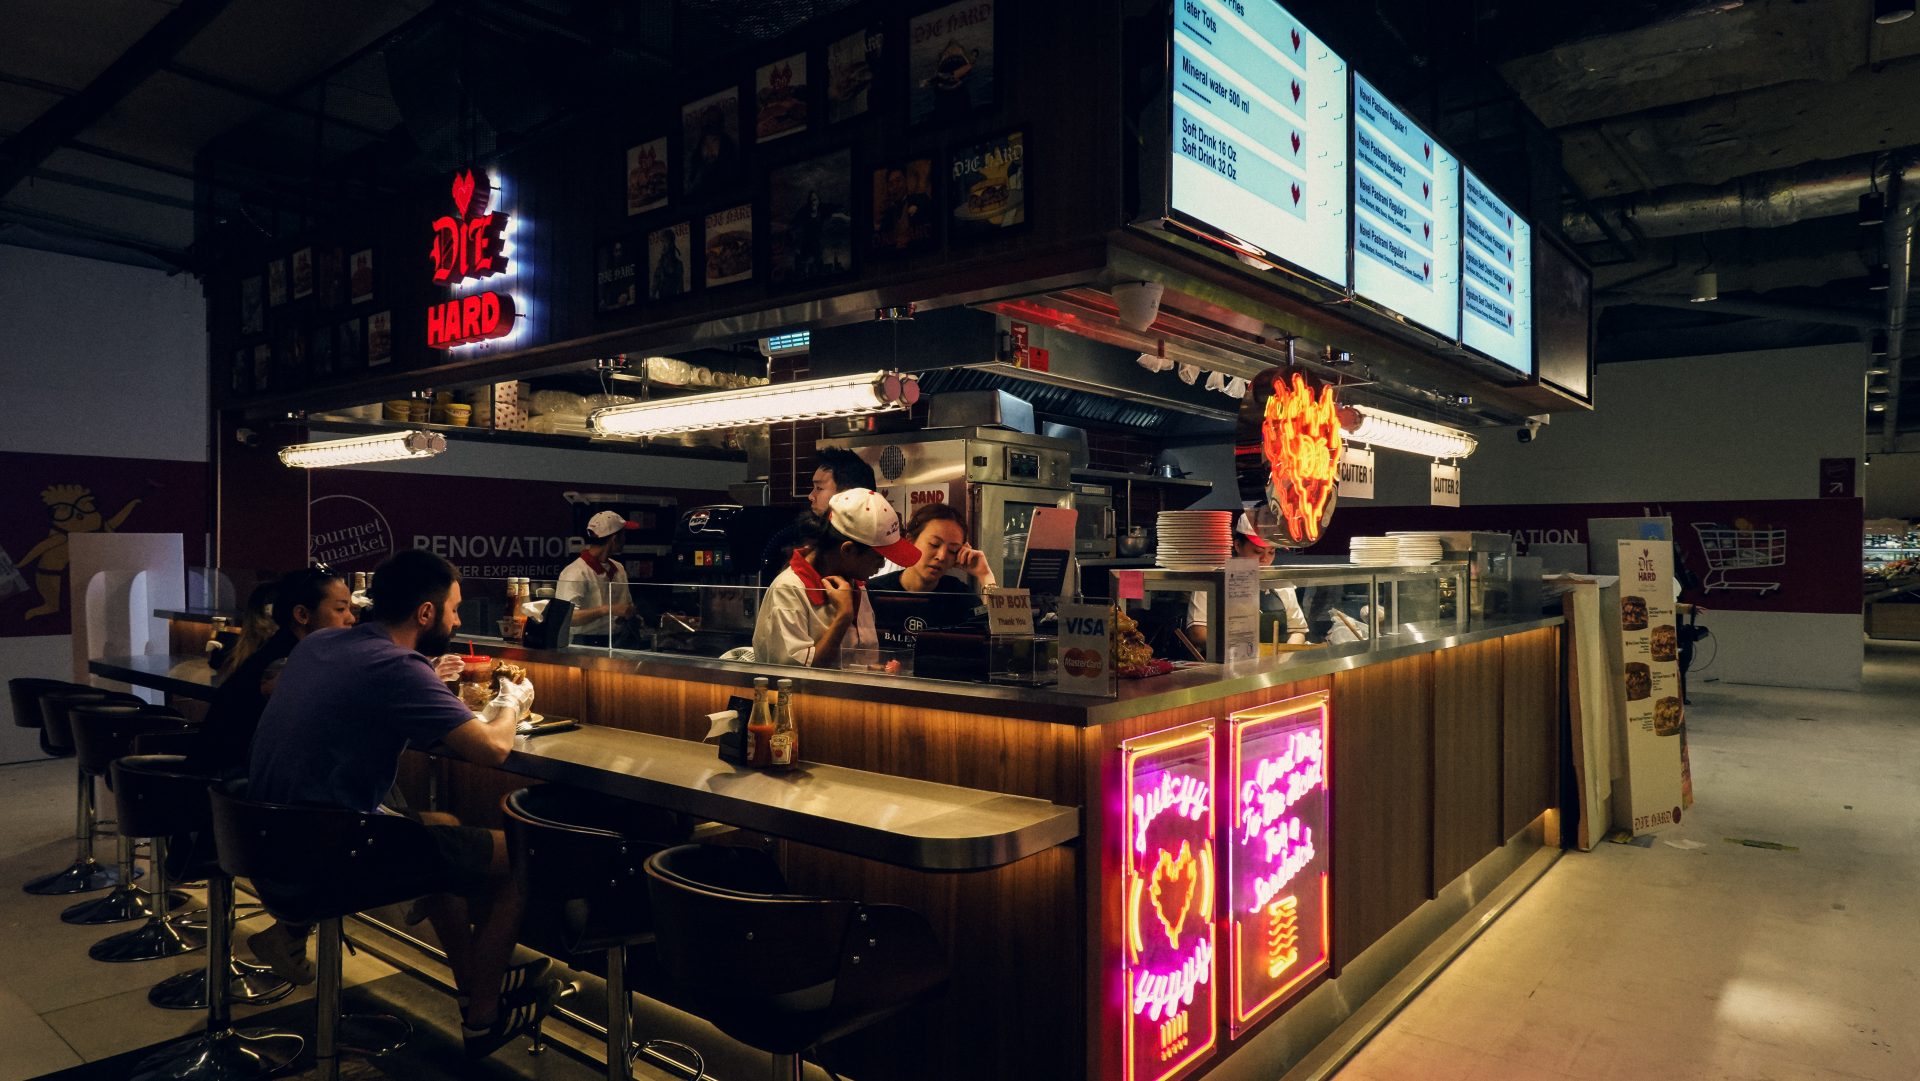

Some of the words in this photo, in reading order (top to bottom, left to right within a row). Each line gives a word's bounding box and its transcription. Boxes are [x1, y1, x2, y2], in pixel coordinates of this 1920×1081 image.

[1202, 10, 1216, 33] Tots
[1182, 56, 1208, 84] Mineral
[1210, 79, 1228, 99] water
[1229, 90, 1240, 108] 500
[1242, 101, 1250, 114] ml
[1372, 96, 1389, 120] Pastrami
[1182, 118, 1197, 139] Soft
[1198, 128, 1217, 150] Drink
[1218, 140, 1226, 155] 16
[1228, 144, 1237, 162] Oz
[1182, 137, 1197, 157] Soft
[1198, 146, 1217, 168] Drink
[1218, 158, 1226, 173] 32
[1228, 163, 1237, 180] Oz
[1371, 140, 1388, 164] Pastrami
[1372, 186, 1388, 207] Pastrami
[430, 214, 494, 282] DIE
[1372, 230, 1388, 249] Pastrami
[427, 291, 501, 346] HARD
[1342, 463, 1367, 484] CUTTER
[1370, 468, 1372, 484] 1
[1434, 477, 1454, 494] CUTTER
[1455, 481, 1459, 494] 2
[911, 490, 944, 504] SAND
[1510, 529, 1579, 544] ATION
[320, 534, 387, 564] market
[459, 565, 479, 577] TER
[1638, 572, 1656, 582] HARD
[989, 595, 1004, 608] TIP
[1008, 595, 1028, 608] BOX
[1016, 618, 1026, 626] You
[1066, 617, 1104, 636] VISA
[1064, 658, 1102, 668] MasterCard
